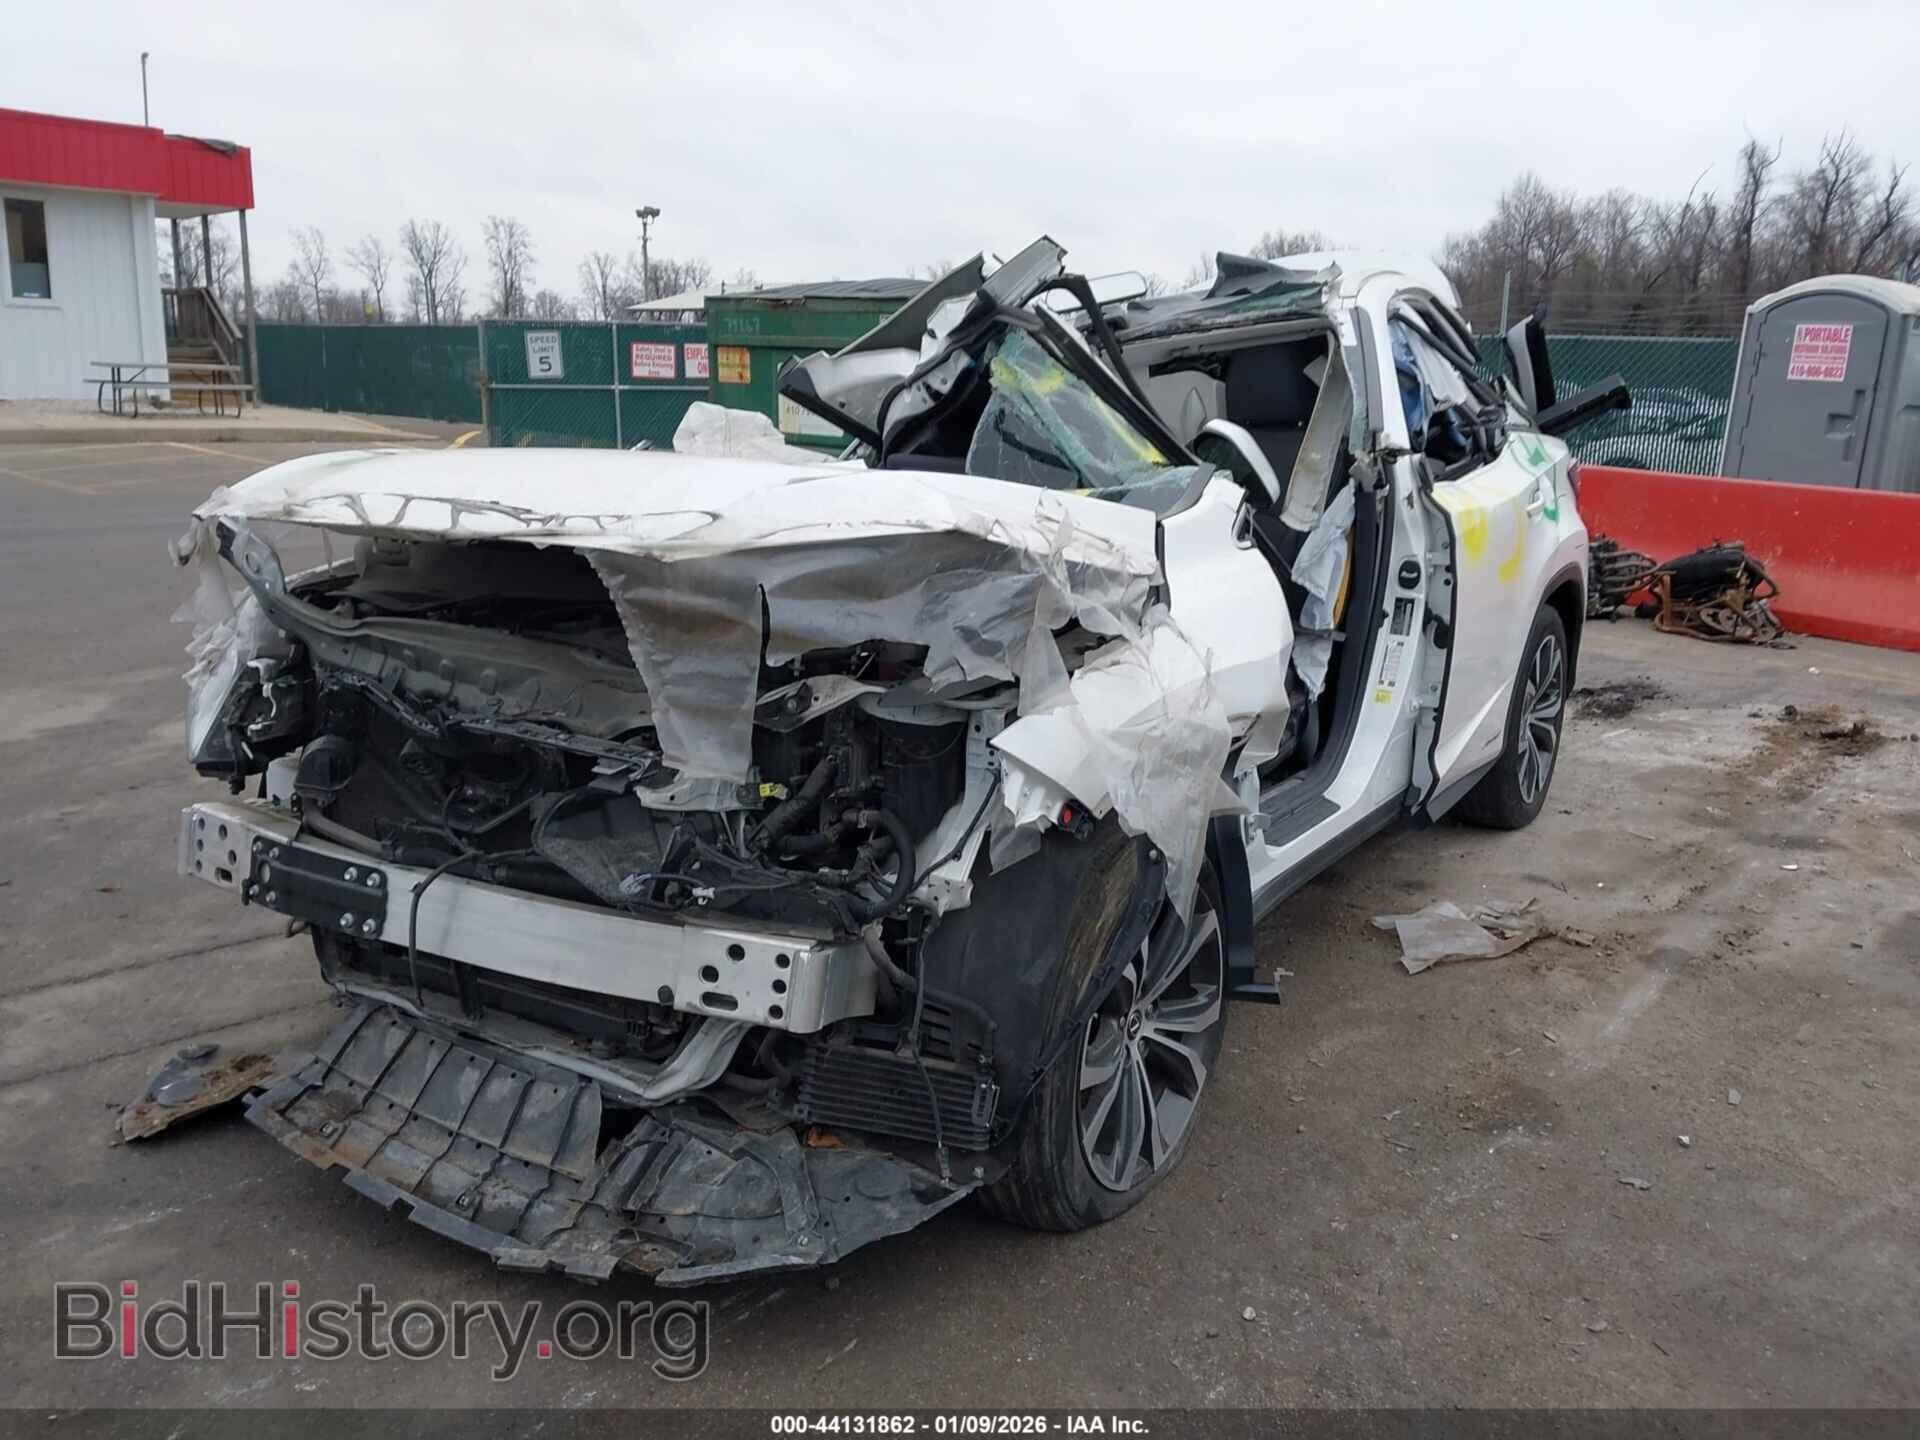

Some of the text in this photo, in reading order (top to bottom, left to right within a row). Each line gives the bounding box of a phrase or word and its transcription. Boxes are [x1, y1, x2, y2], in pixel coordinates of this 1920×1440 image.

[529, 335, 558, 344] SPEED
[1804, 327, 1851, 343] PORTABLE
[532, 345, 555, 353] LIMIT
[635, 353, 674, 361] REQUIRED
[539, 356, 552, 372] 5
